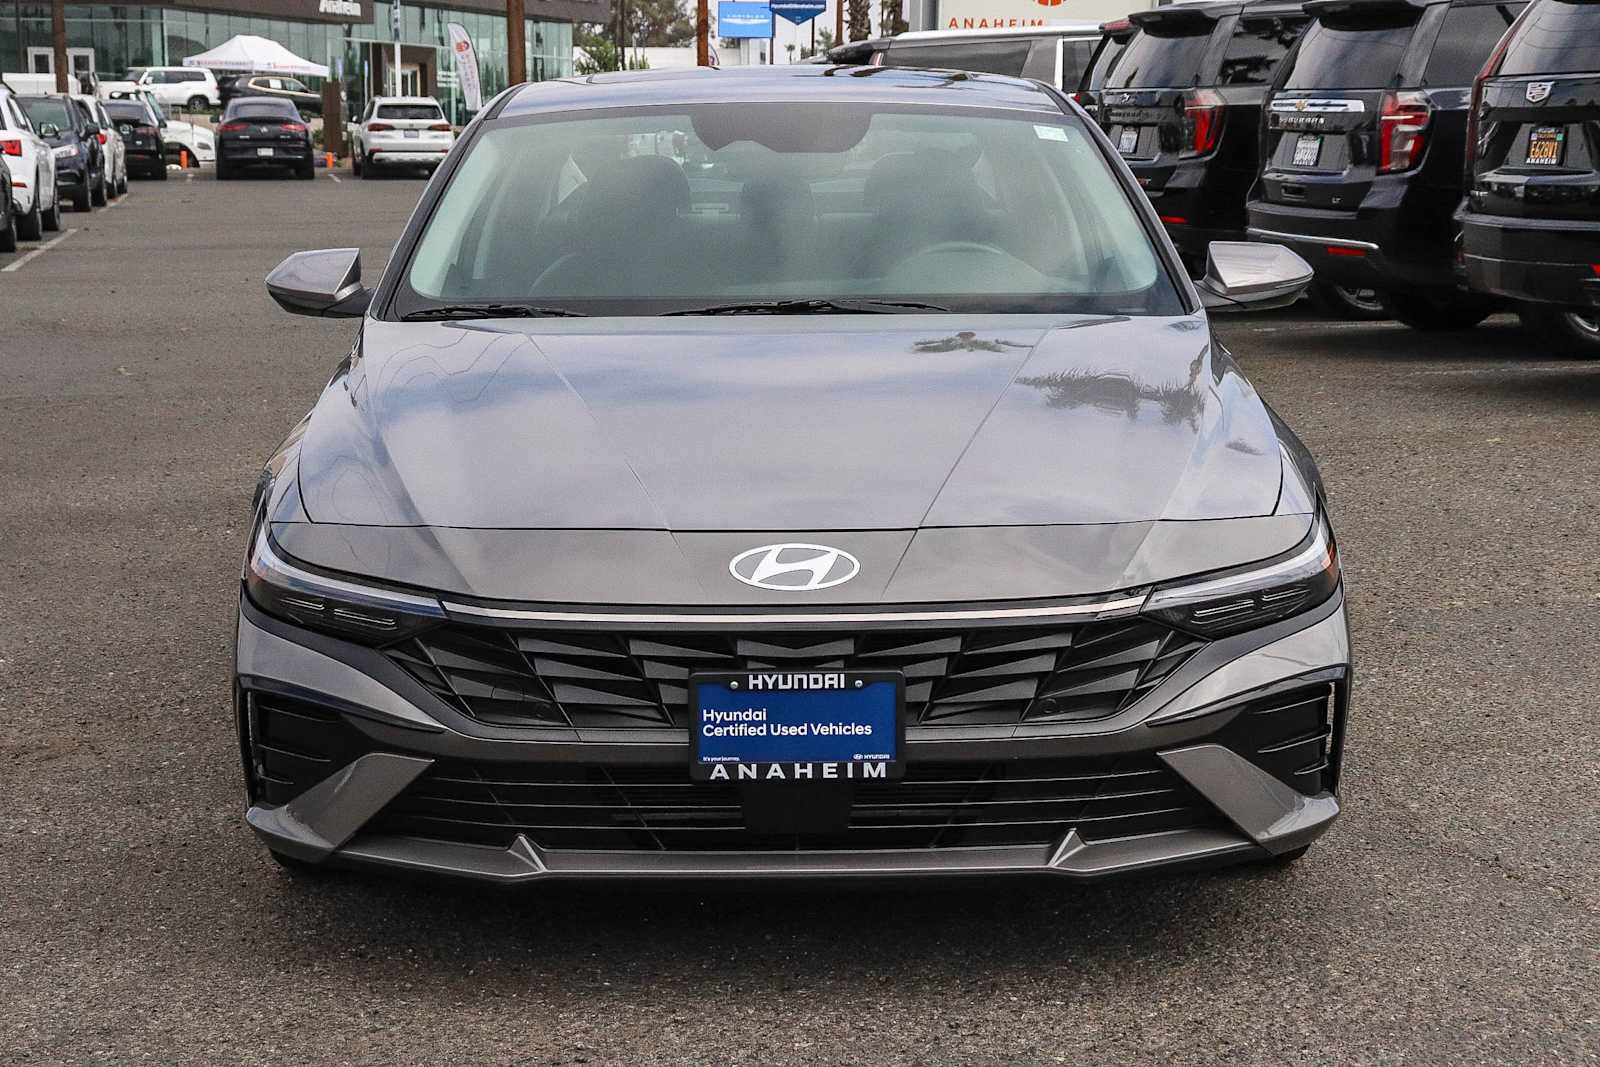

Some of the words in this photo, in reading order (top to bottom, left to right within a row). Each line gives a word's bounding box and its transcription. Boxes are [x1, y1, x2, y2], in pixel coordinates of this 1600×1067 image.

[949, 17, 1044, 29] ANAHEIM
[748, 673, 846, 690] HYUNDAI
[702, 708, 767, 724] Hyundai
[702, 724, 767, 737] Certified
[770, 724, 808, 736] Used
[810, 723, 872, 736] Vehicles
[709, 762, 887, 781] ANAHEIM
